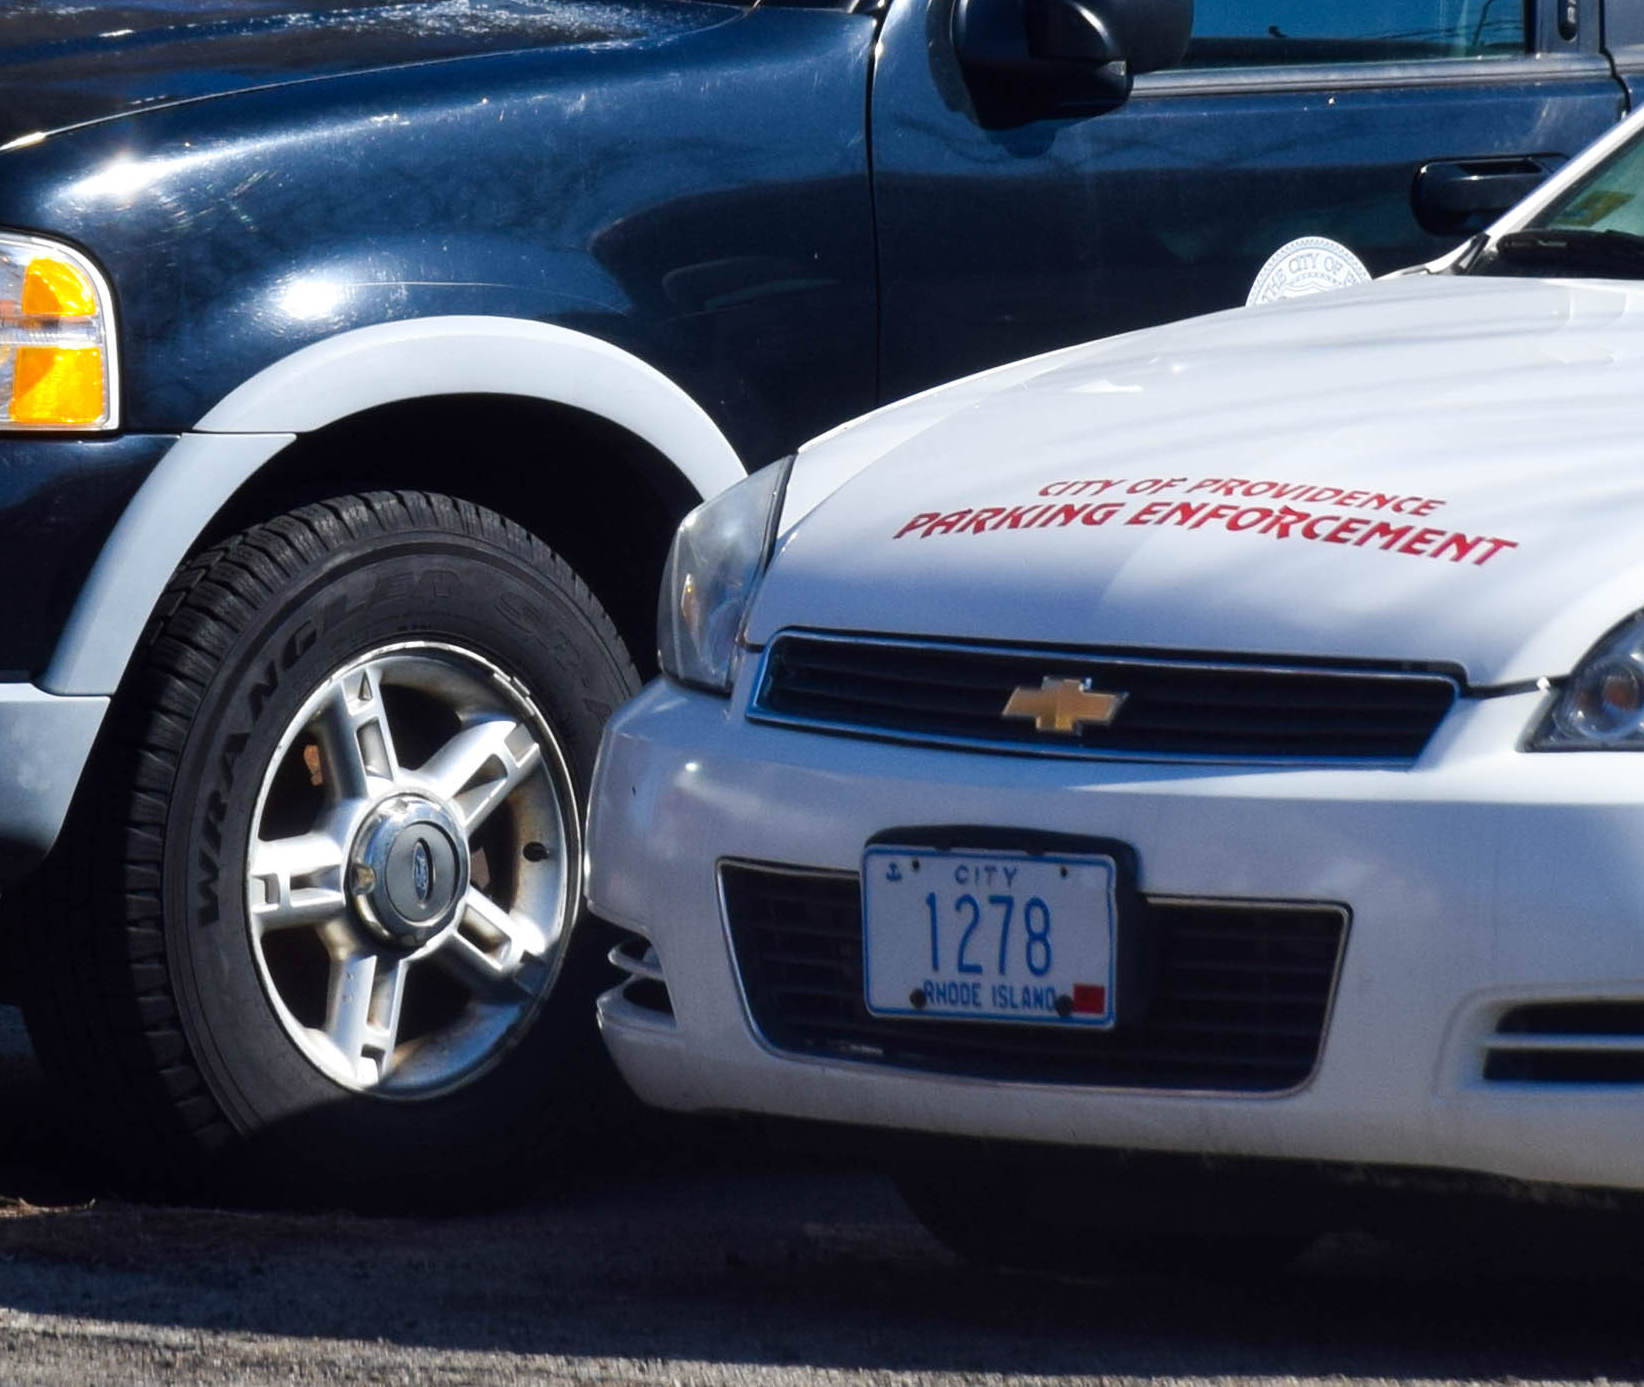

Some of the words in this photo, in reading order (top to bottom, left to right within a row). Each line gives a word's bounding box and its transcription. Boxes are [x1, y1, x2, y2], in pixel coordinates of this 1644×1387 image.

[1288, 252, 1320, 274] CITY
[1324, 255, 1343, 276] OF
[1038, 478, 1128, 498] CITY
[1126, 476, 1190, 495] OF
[1186, 477, 1447, 517] PROVIDENCE
[893, 501, 1126, 541] PARKING
[1125, 501, 1520, 567] ENFORCEMENT
[198, 568, 461, 927] WRANGLER
[954, 865, 1017, 887] CITY
[925, 891, 1052, 978] 1278
[923, 979, 982, 1008] RHODE
[992, 983, 1057, 1012] ISLAND
